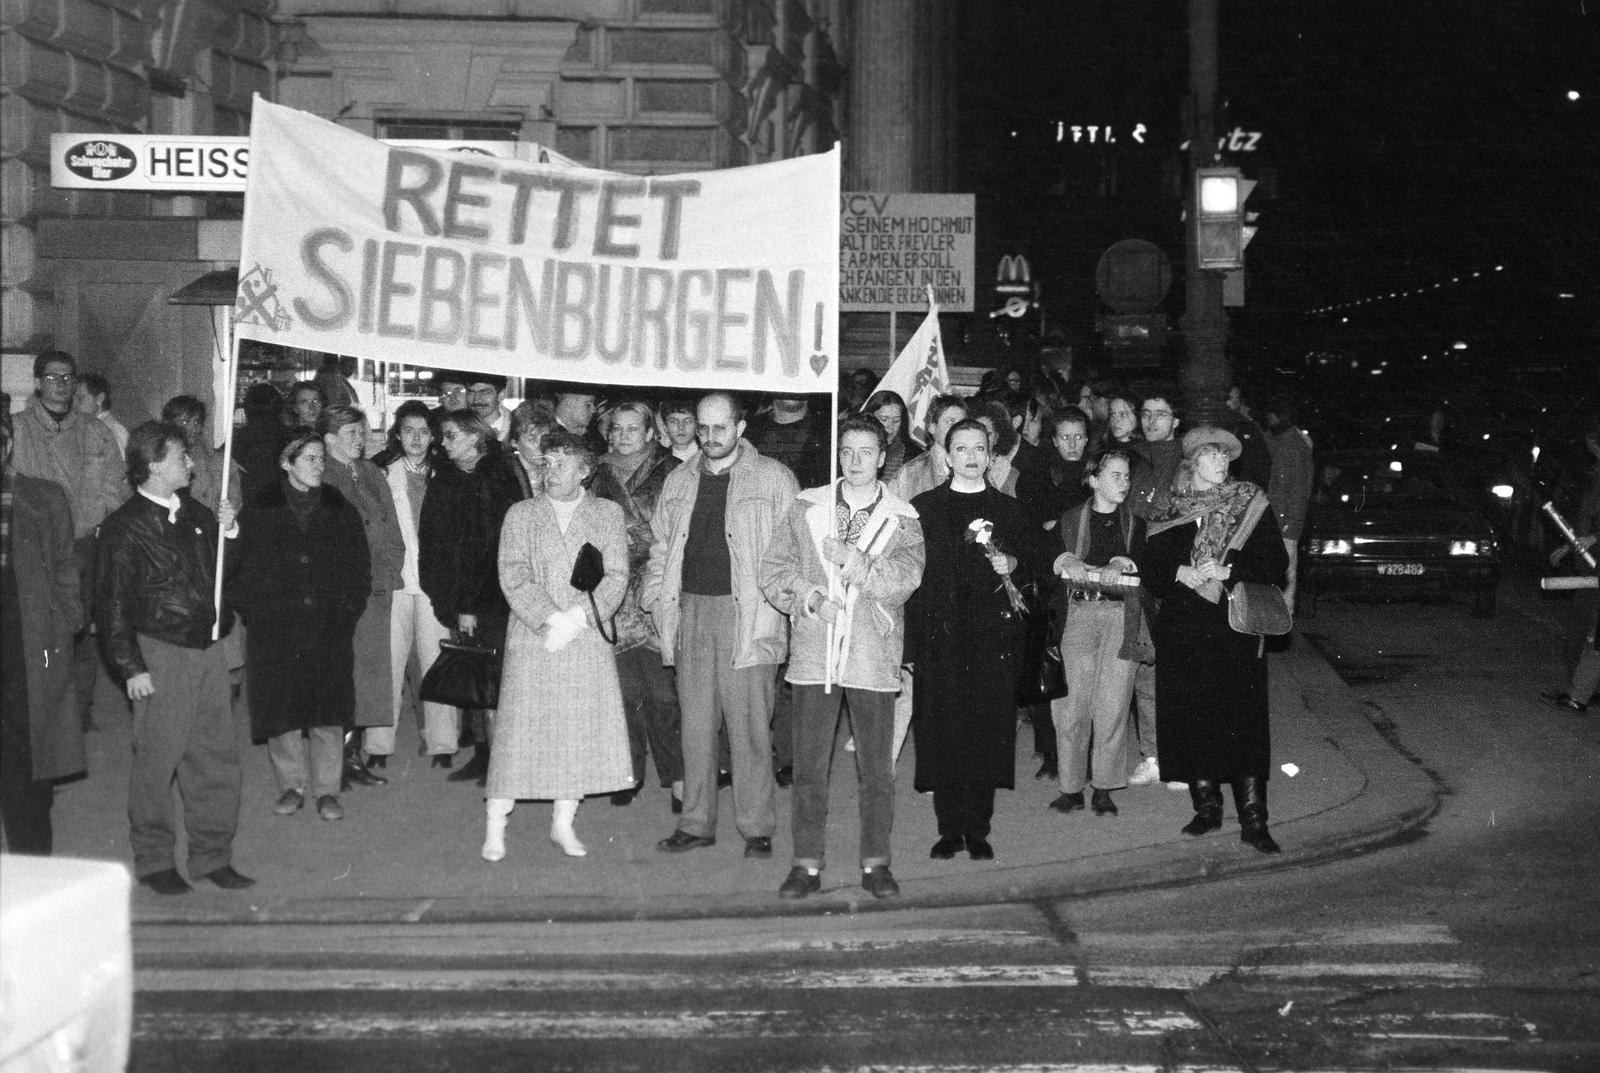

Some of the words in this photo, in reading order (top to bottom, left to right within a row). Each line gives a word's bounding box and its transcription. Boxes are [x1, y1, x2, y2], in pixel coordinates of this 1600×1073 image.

[383, 147, 702, 260] RETTET
[844, 216, 904, 233] SEINEM
[908, 216, 973, 234] HOCHMUT
[871, 234, 895, 251] DER
[898, 234, 955, 251] FREVLER
[857, 269, 914, 286] FANGEN
[936, 269, 961, 286] DEN
